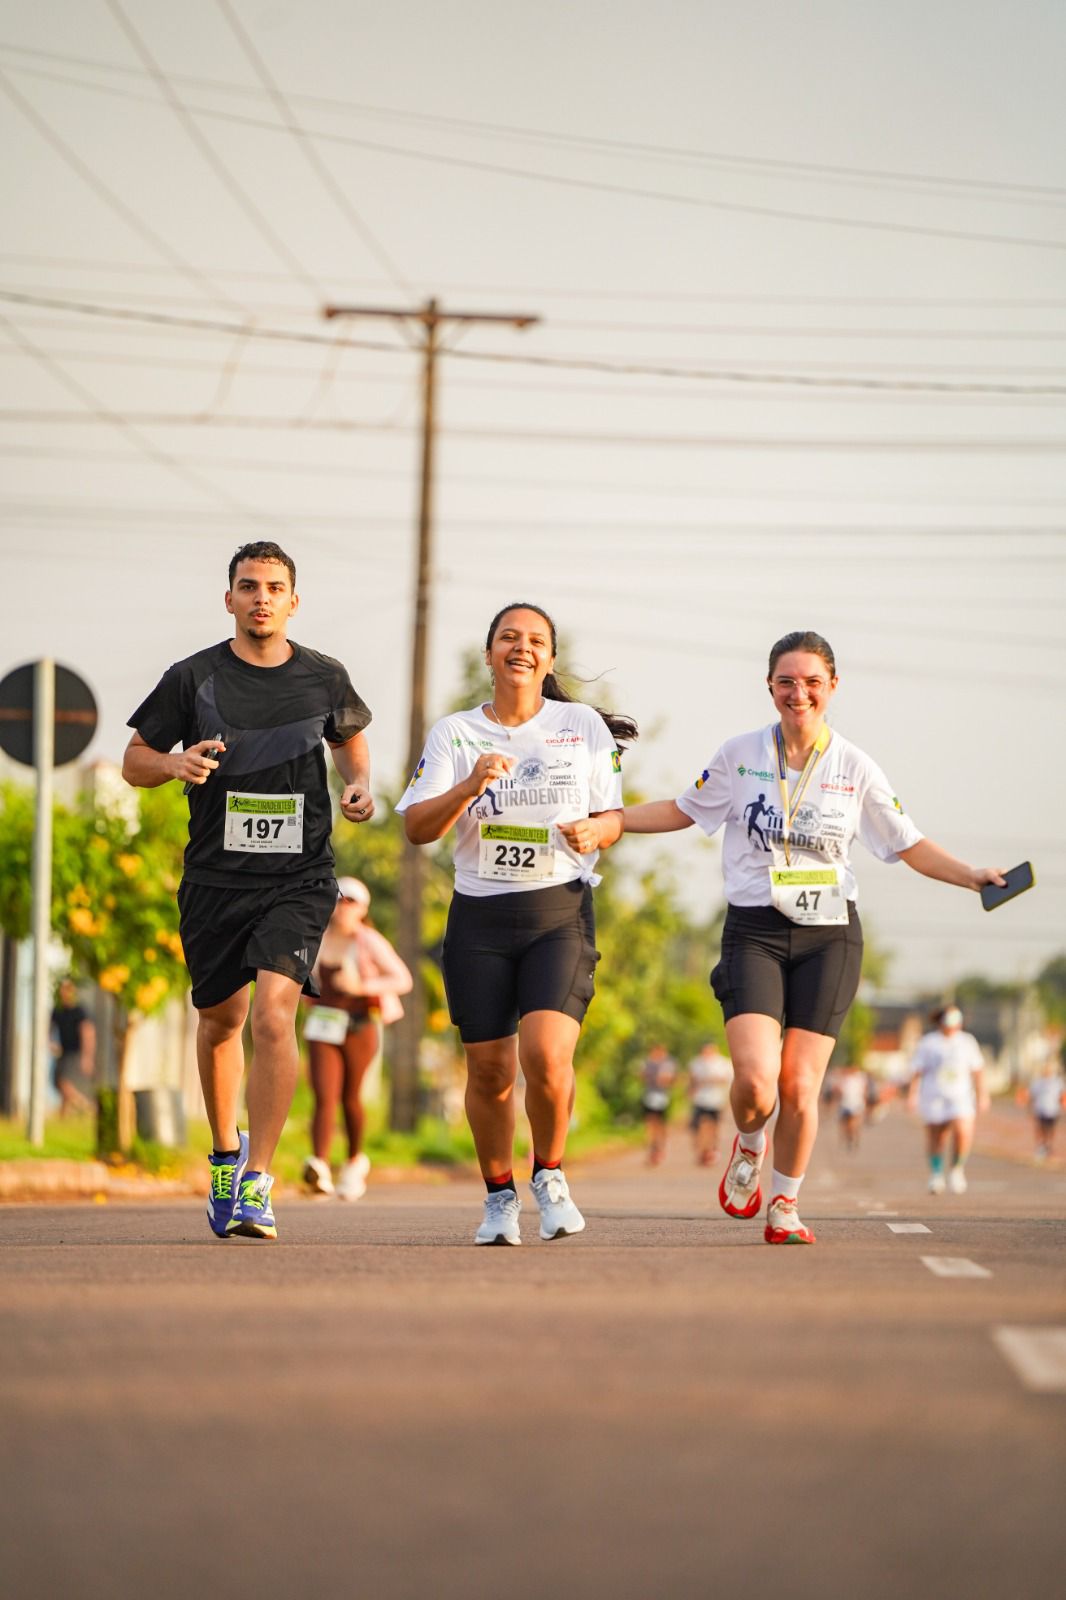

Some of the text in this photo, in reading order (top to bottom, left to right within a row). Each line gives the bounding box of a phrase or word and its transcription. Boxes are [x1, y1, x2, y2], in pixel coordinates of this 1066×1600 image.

[495, 788, 582, 808] TIRADENTES
[242, 817, 285, 839] 197
[494, 844, 536, 869] 232
[795, 890, 822, 911] 47
